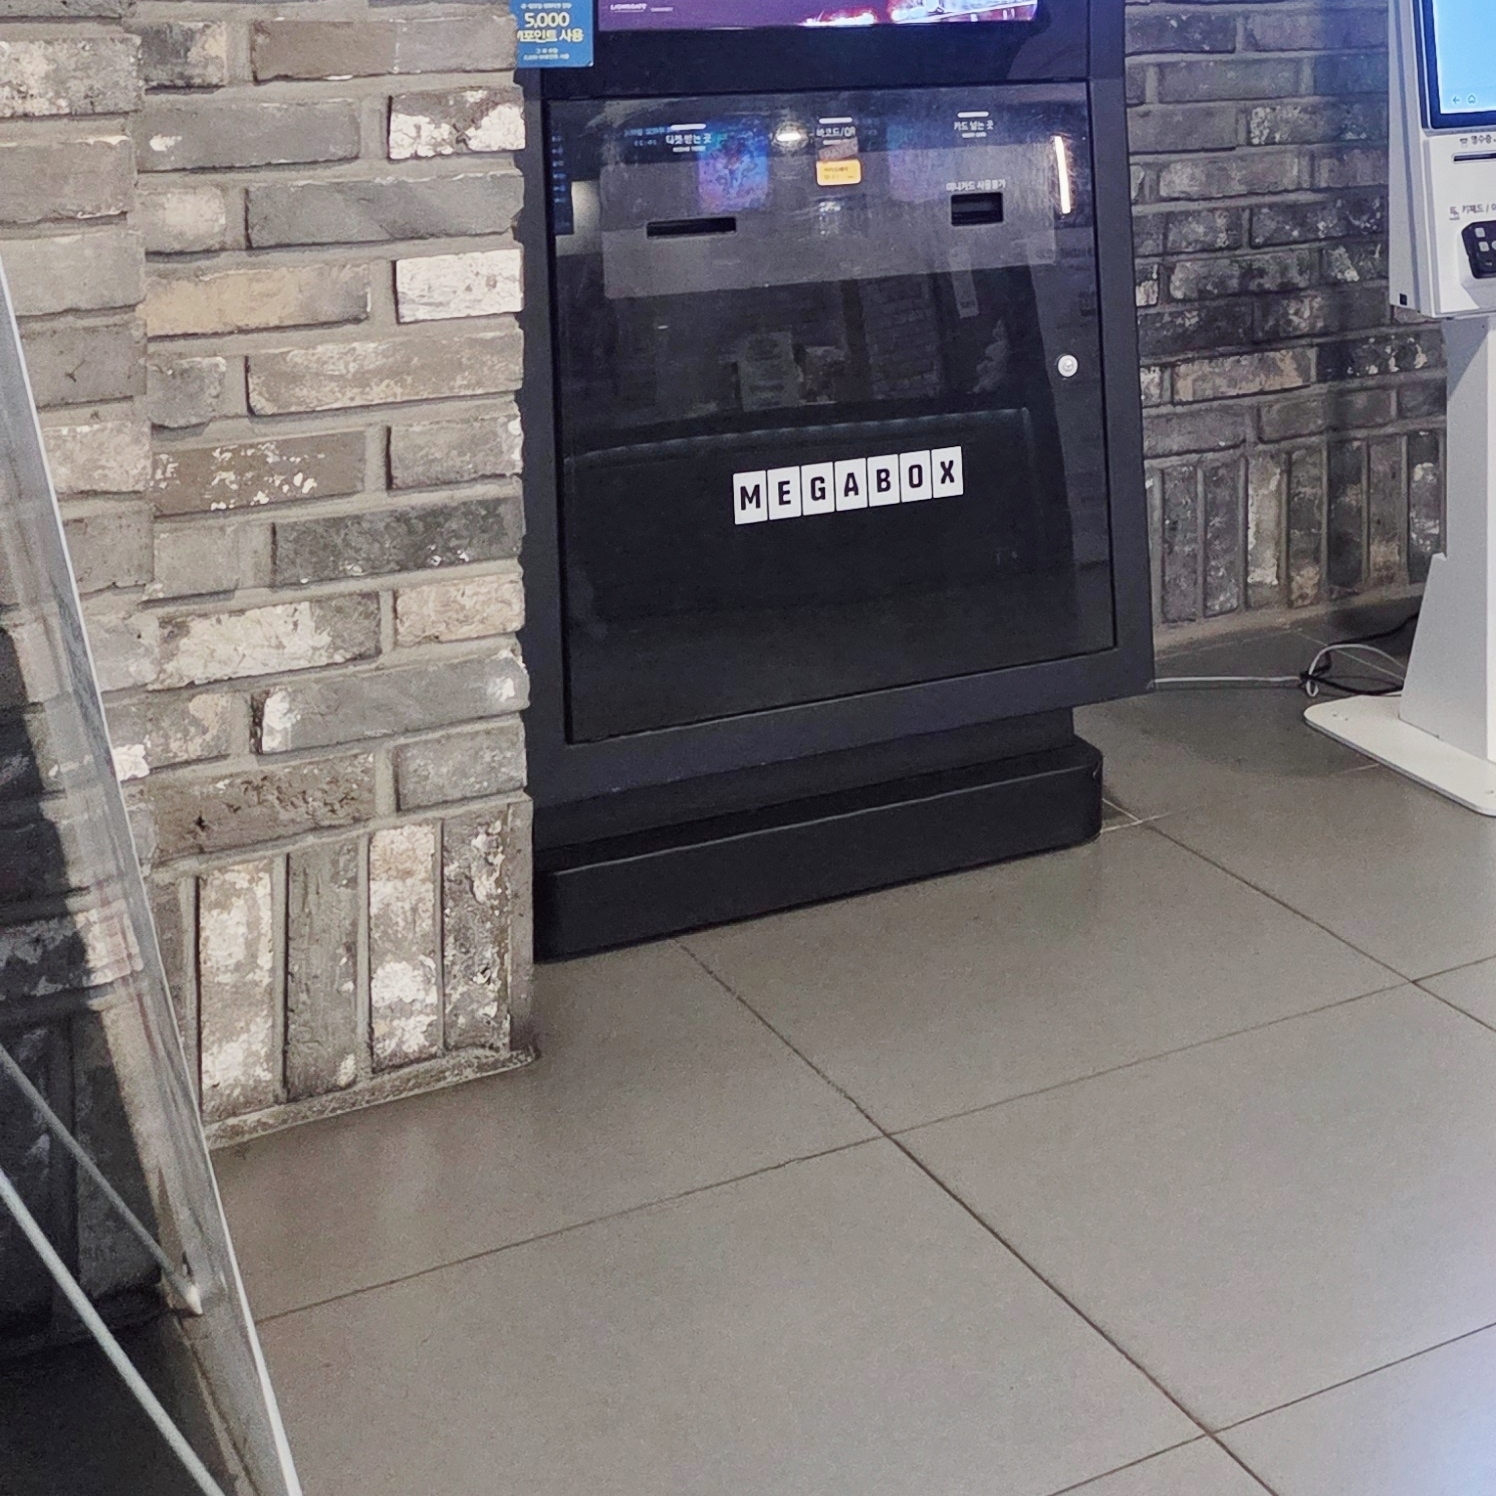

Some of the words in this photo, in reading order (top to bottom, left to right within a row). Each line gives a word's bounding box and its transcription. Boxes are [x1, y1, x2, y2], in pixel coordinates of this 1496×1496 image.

[524, 12, 570, 29] 5,000
[559, 28, 584, 43] 사용
[1470, 134, 1492, 145] 영수증
[738, 458, 956, 512] MEGABOX
